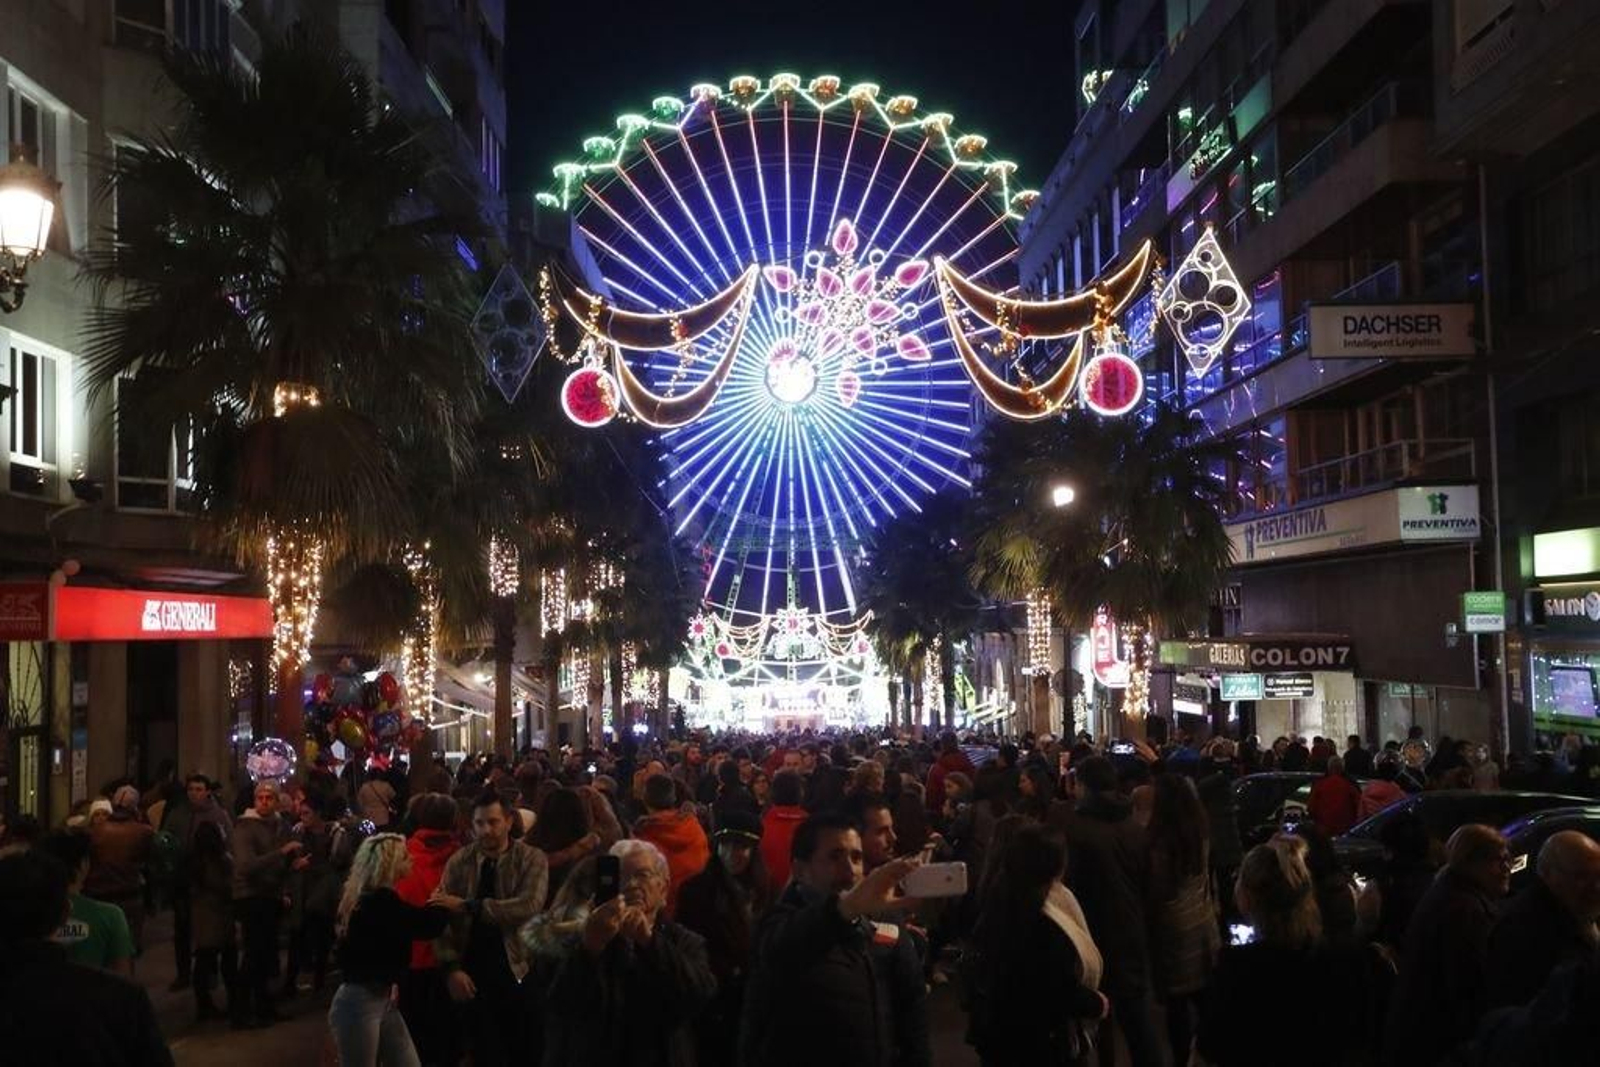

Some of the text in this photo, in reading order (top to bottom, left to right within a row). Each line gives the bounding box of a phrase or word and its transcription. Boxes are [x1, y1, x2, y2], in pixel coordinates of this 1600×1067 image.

[1343, 315, 1442, 335] DACHSER
[1343, 338, 1393, 349] Intelligent
[1256, 508, 1327, 543] PREVENTIVA
[1402, 518, 1477, 530] PREVENTIVA
[161, 600, 216, 632] GENERALI
